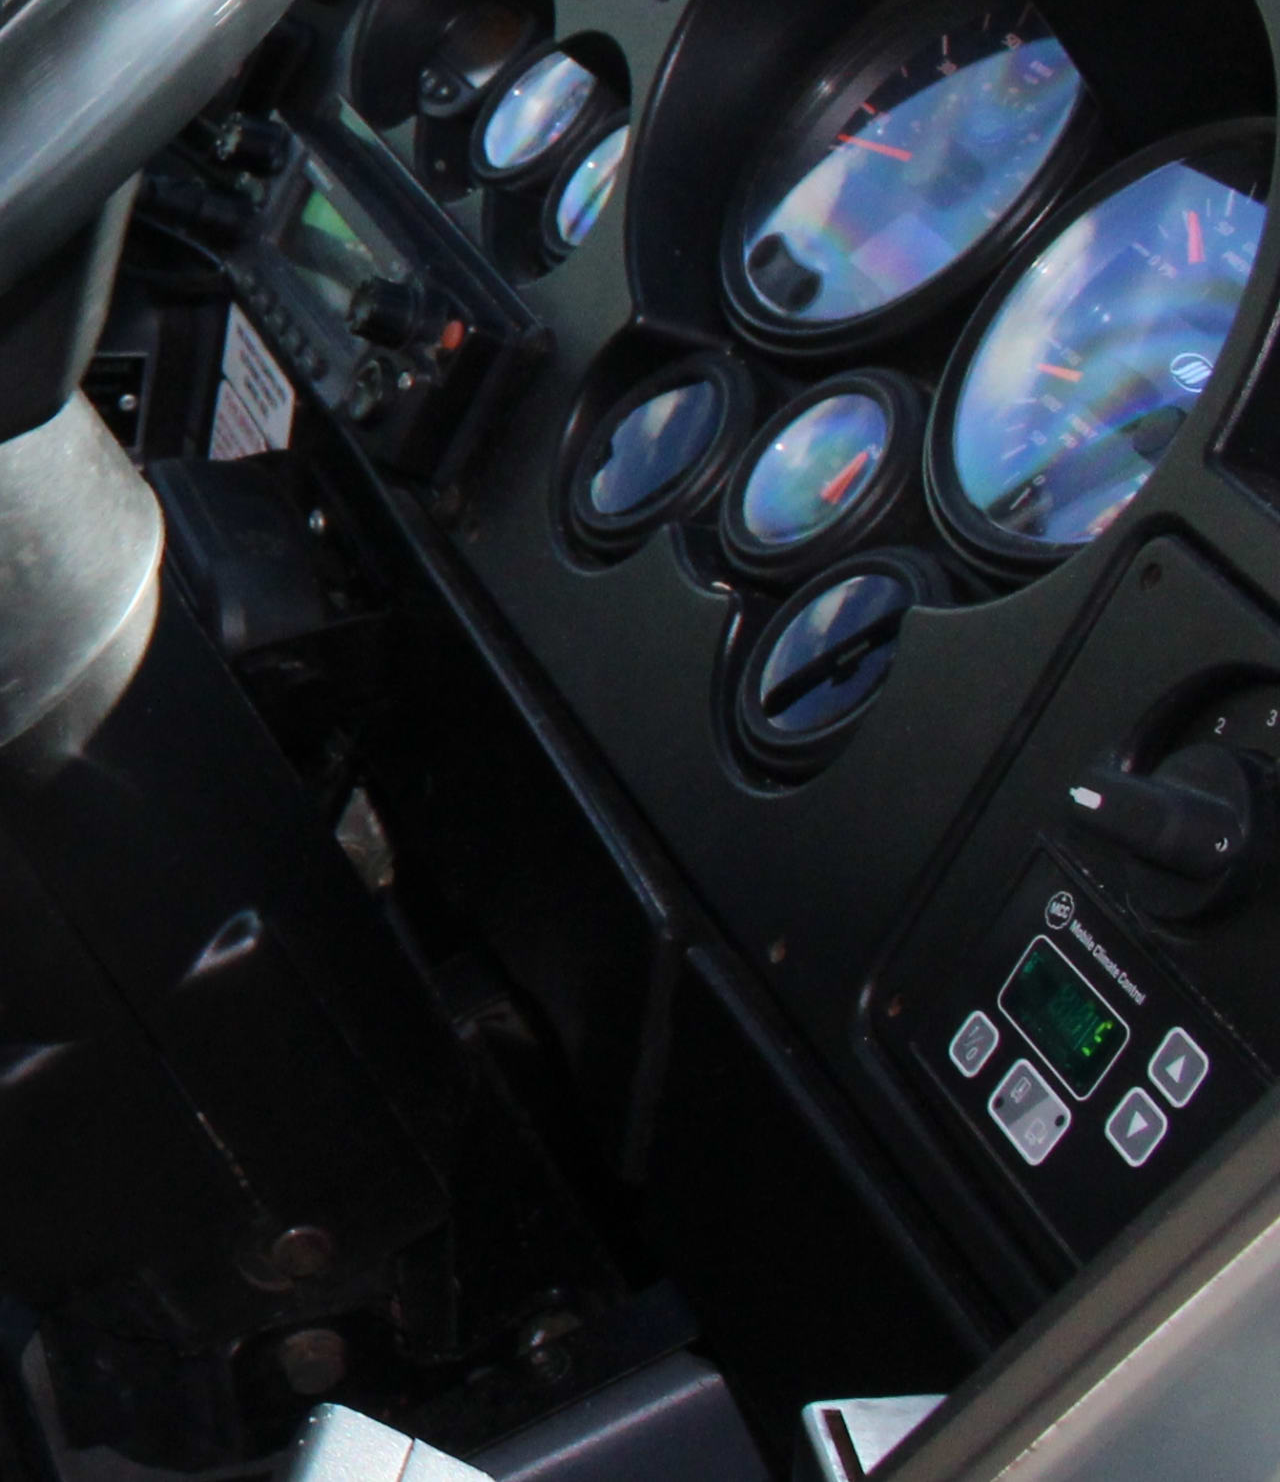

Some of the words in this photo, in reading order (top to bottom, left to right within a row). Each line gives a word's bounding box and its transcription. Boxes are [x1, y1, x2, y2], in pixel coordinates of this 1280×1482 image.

[1214, 717, 1226, 734] 2
[1266, 709, 1278, 727] 3
[1050, 901, 1071, 919] MCC
[1069, 919, 1095, 951] Mobile
[1092, 944, 1120, 979] Climate
[1117, 971, 1146, 1006] Control
